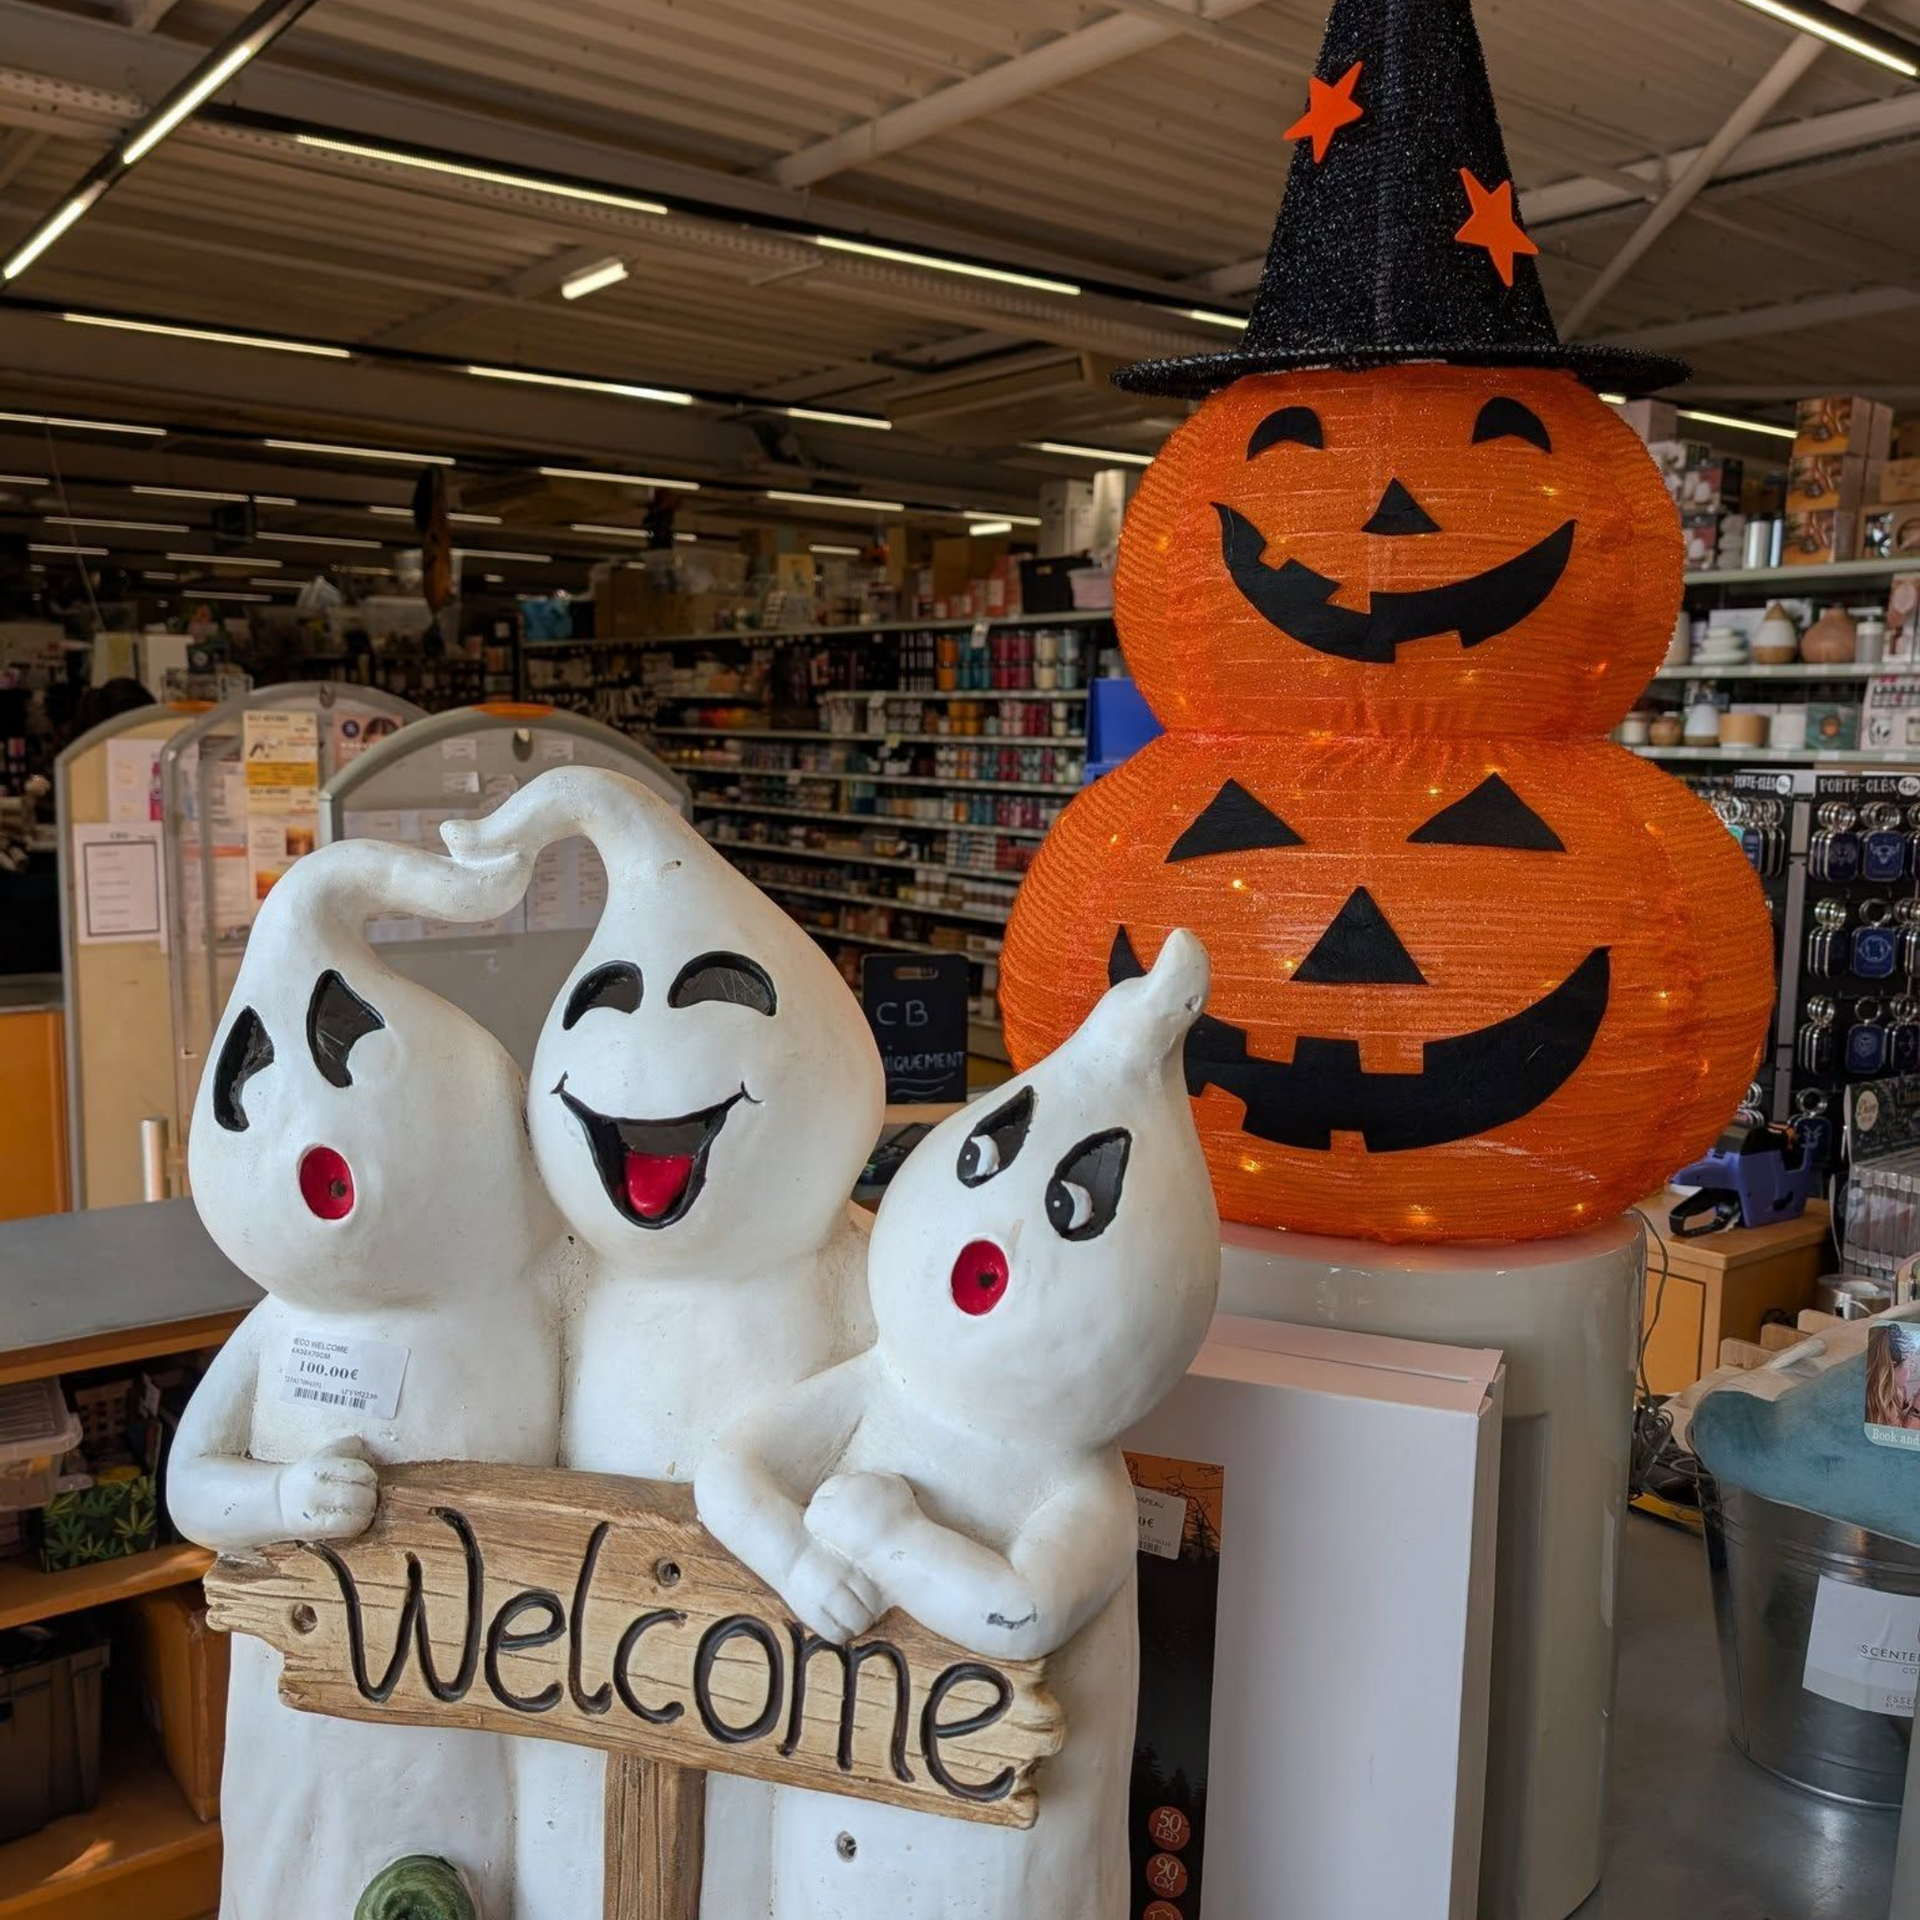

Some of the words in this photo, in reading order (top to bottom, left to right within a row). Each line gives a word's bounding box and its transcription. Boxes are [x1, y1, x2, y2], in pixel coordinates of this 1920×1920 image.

[876, 999, 929, 1027] CB
[311, 1340, 349, 1354] WELCOME
[299, 1360, 360, 1380] 100.00€
[1872, 1428, 1898, 1443] Book
[1899, 1434, 1920, 1446] and
[306, 1506, 1015, 1802] Welcome
[1157, 1809, 1182, 1833] 50
[1155, 1828, 1180, 1843] LED
[1156, 1857, 1179, 1880] 90
[1154, 1875, 1175, 1891] CM
